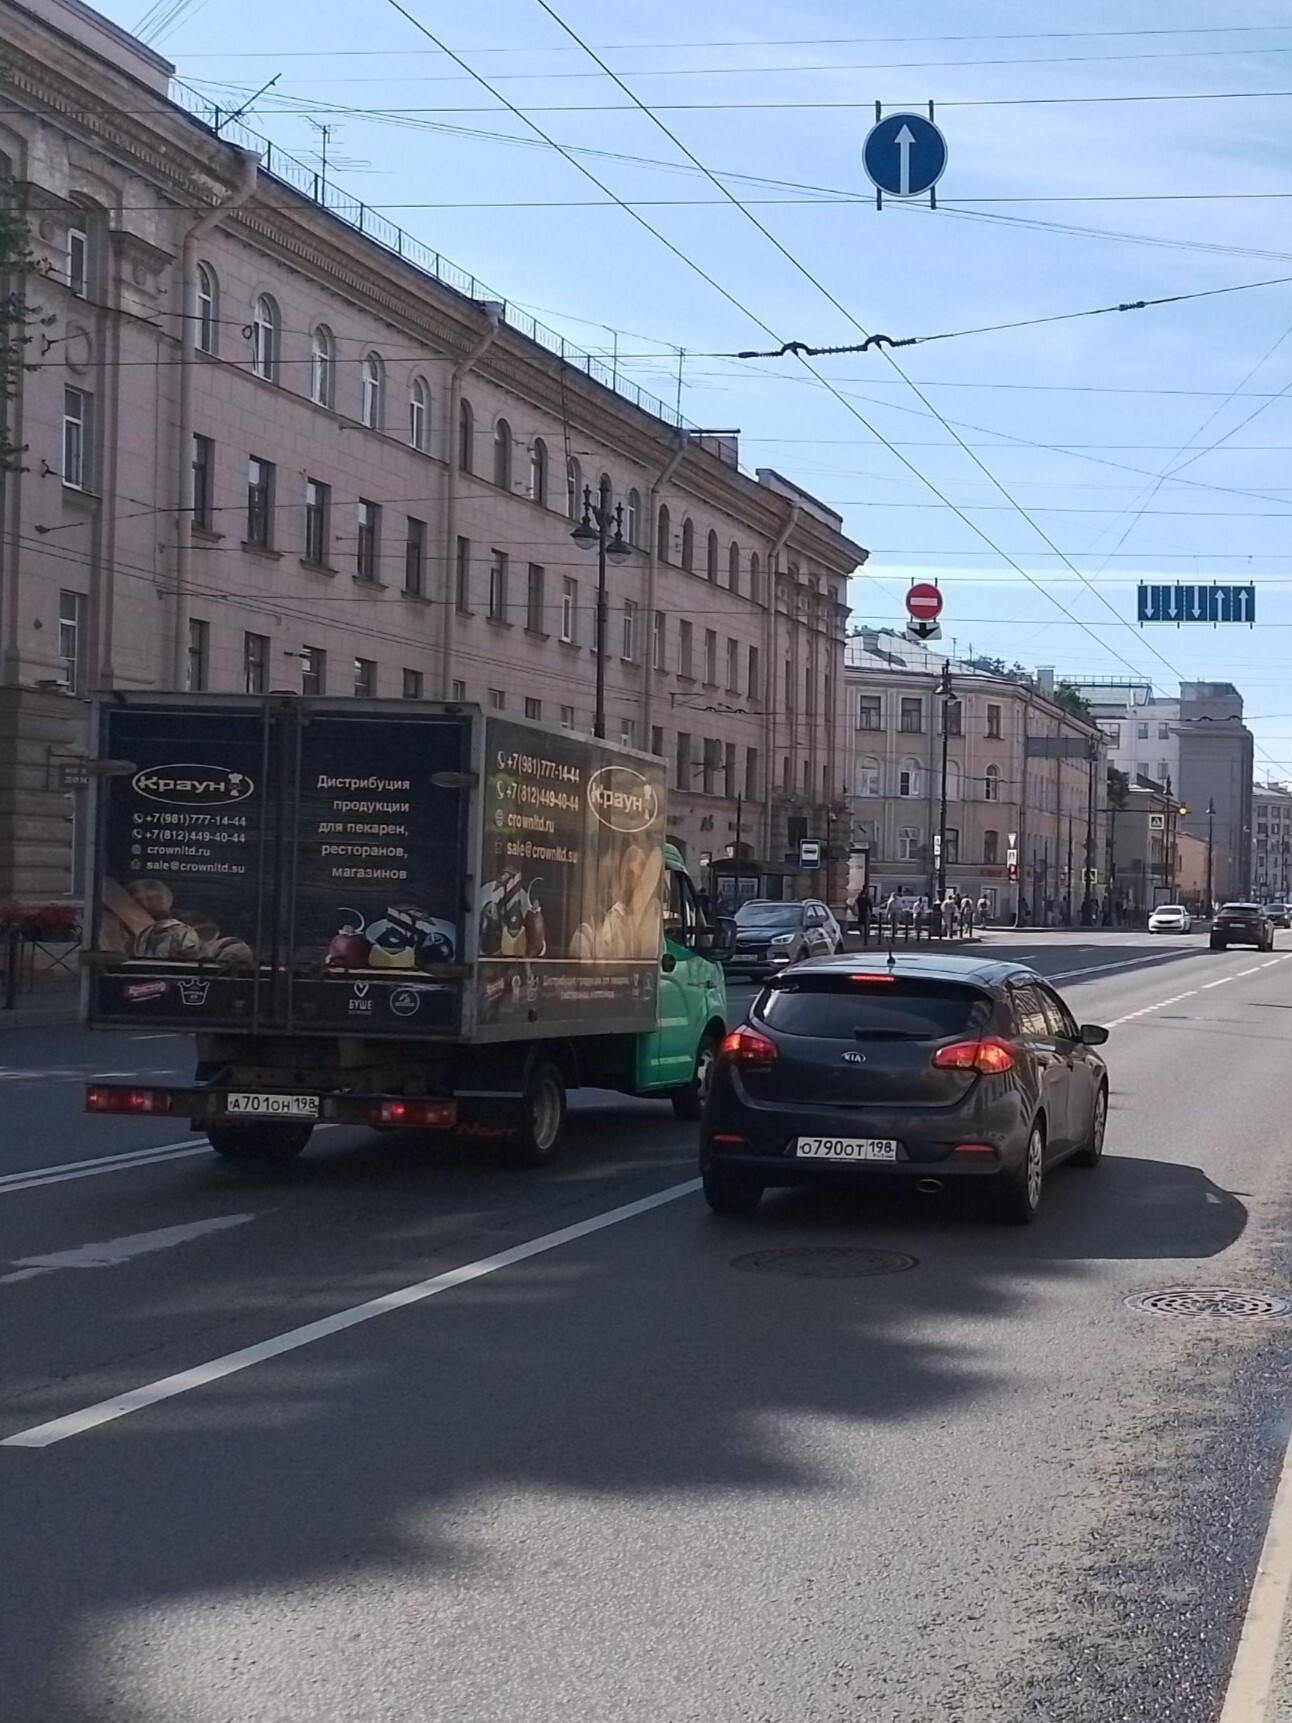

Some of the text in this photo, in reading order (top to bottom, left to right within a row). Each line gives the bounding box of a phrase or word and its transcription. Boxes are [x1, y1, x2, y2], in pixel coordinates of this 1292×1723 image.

[138, 776, 226, 794] Краун
[317, 775, 410, 791] Дистрибуция
[590, 782, 643, 813] Краун
[333, 800, 410, 813] продукции
[145, 813, 246, 826] +7(981)777-14-44
[144, 829, 245, 843] +7(812)449-40-44
[318, 822, 409, 837] для пекарен,
[147, 844, 211, 857] crownltd.ru
[321, 845, 409, 860] ресторанов,
[145, 860, 246, 874] sale@crownltd.su
[331, 867, 408, 880] магазинов
[348, 999, 373, 1010] БУШЕ
